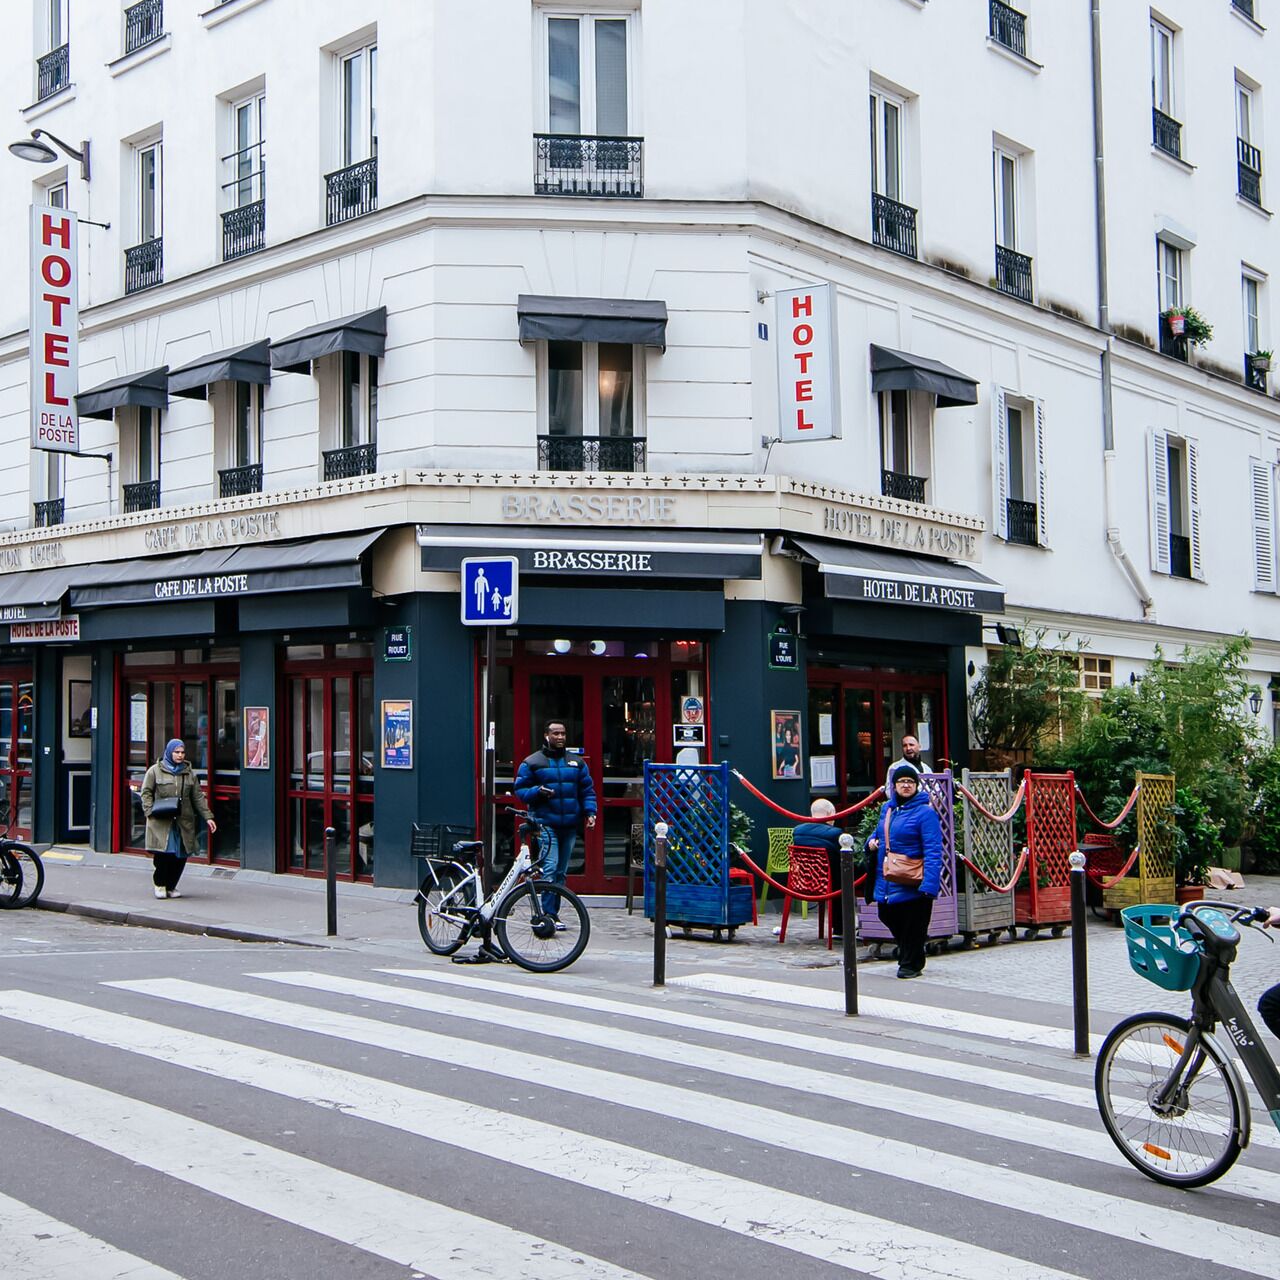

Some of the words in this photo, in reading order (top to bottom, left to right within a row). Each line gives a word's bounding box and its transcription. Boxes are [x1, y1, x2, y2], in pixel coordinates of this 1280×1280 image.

[41, 213, 71, 406] HOTEL
[792, 295, 814, 430] HOTEL
[41, 413, 55, 426] DE
[59, 414, 73, 428] LA
[39, 428, 75, 444] POSTE
[502, 493, 677, 521] BRASSERIE
[824, 507, 877, 537] HOTEL
[881, 518, 903, 542] DE
[904, 522, 925, 547] LA
[929, 527, 976, 557] POSTE
[534, 551, 652, 572] BRASSERIE
[155, 580, 180, 598] CAFE
[182, 579, 196, 595] DE
[198, 577, 212, 595] LA
[214, 574, 248, 593] POSTE
[863, 579, 902, 601] HOTEL
[905, 585, 919, 602] DE
[922, 587, 939, 605] LA
[941, 589, 975, 608] POSTE
[4, 607, 27, 620] HOTEL
[11, 623, 33, 638] HOTEL
[35, 622, 43, 636] DE
[45, 621, 54, 636] LA
[55, 619, 78, 635] POSTE
[391, 634, 403, 642] RUE
[388, 645, 407, 654] RIQUET
